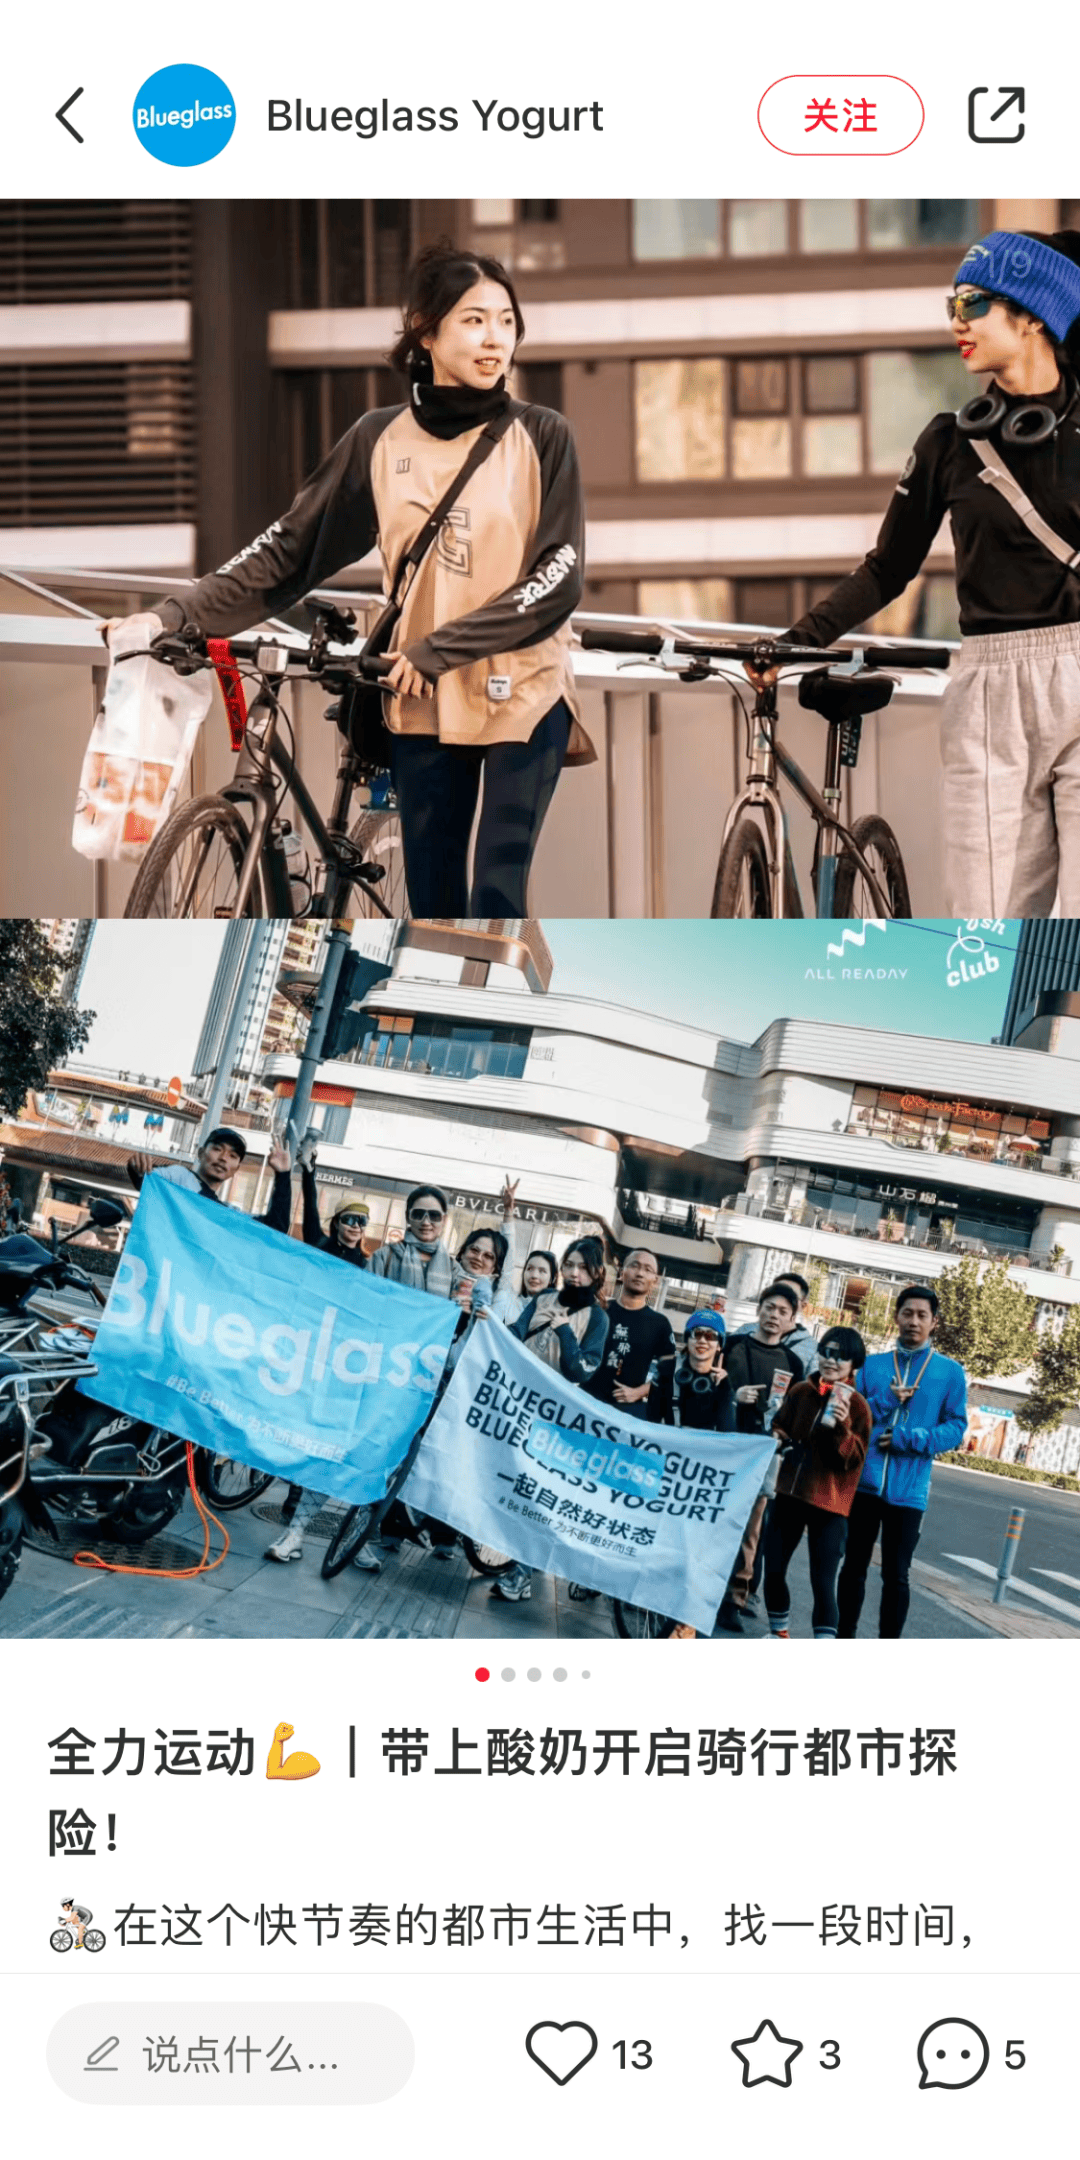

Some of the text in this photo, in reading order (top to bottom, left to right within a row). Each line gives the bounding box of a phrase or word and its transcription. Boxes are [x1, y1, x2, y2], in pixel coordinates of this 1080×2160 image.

[137, 99, 232, 129] Blueglass
[268, 98, 604, 140] Blueglass Yogurt
[803, 97, 878, 134] 关注
[100, 1253, 451, 1396] Blueglass
[532, 1427, 659, 1488] Blueglass
[496, 1471, 657, 1547] 一起自然好状态
[609, 1488, 726, 1524] YOGURT
[554, 1520, 639, 1558] 为不断更好而生
[47, 1726, 256, 1777] 全力运动
[381, 1726, 958, 1777] 带上酸奶开启骑行都市探
[612, 2039, 653, 2071] 13
[819, 2039, 841, 2071] 3
[1004, 2039, 1027, 2071] 5
